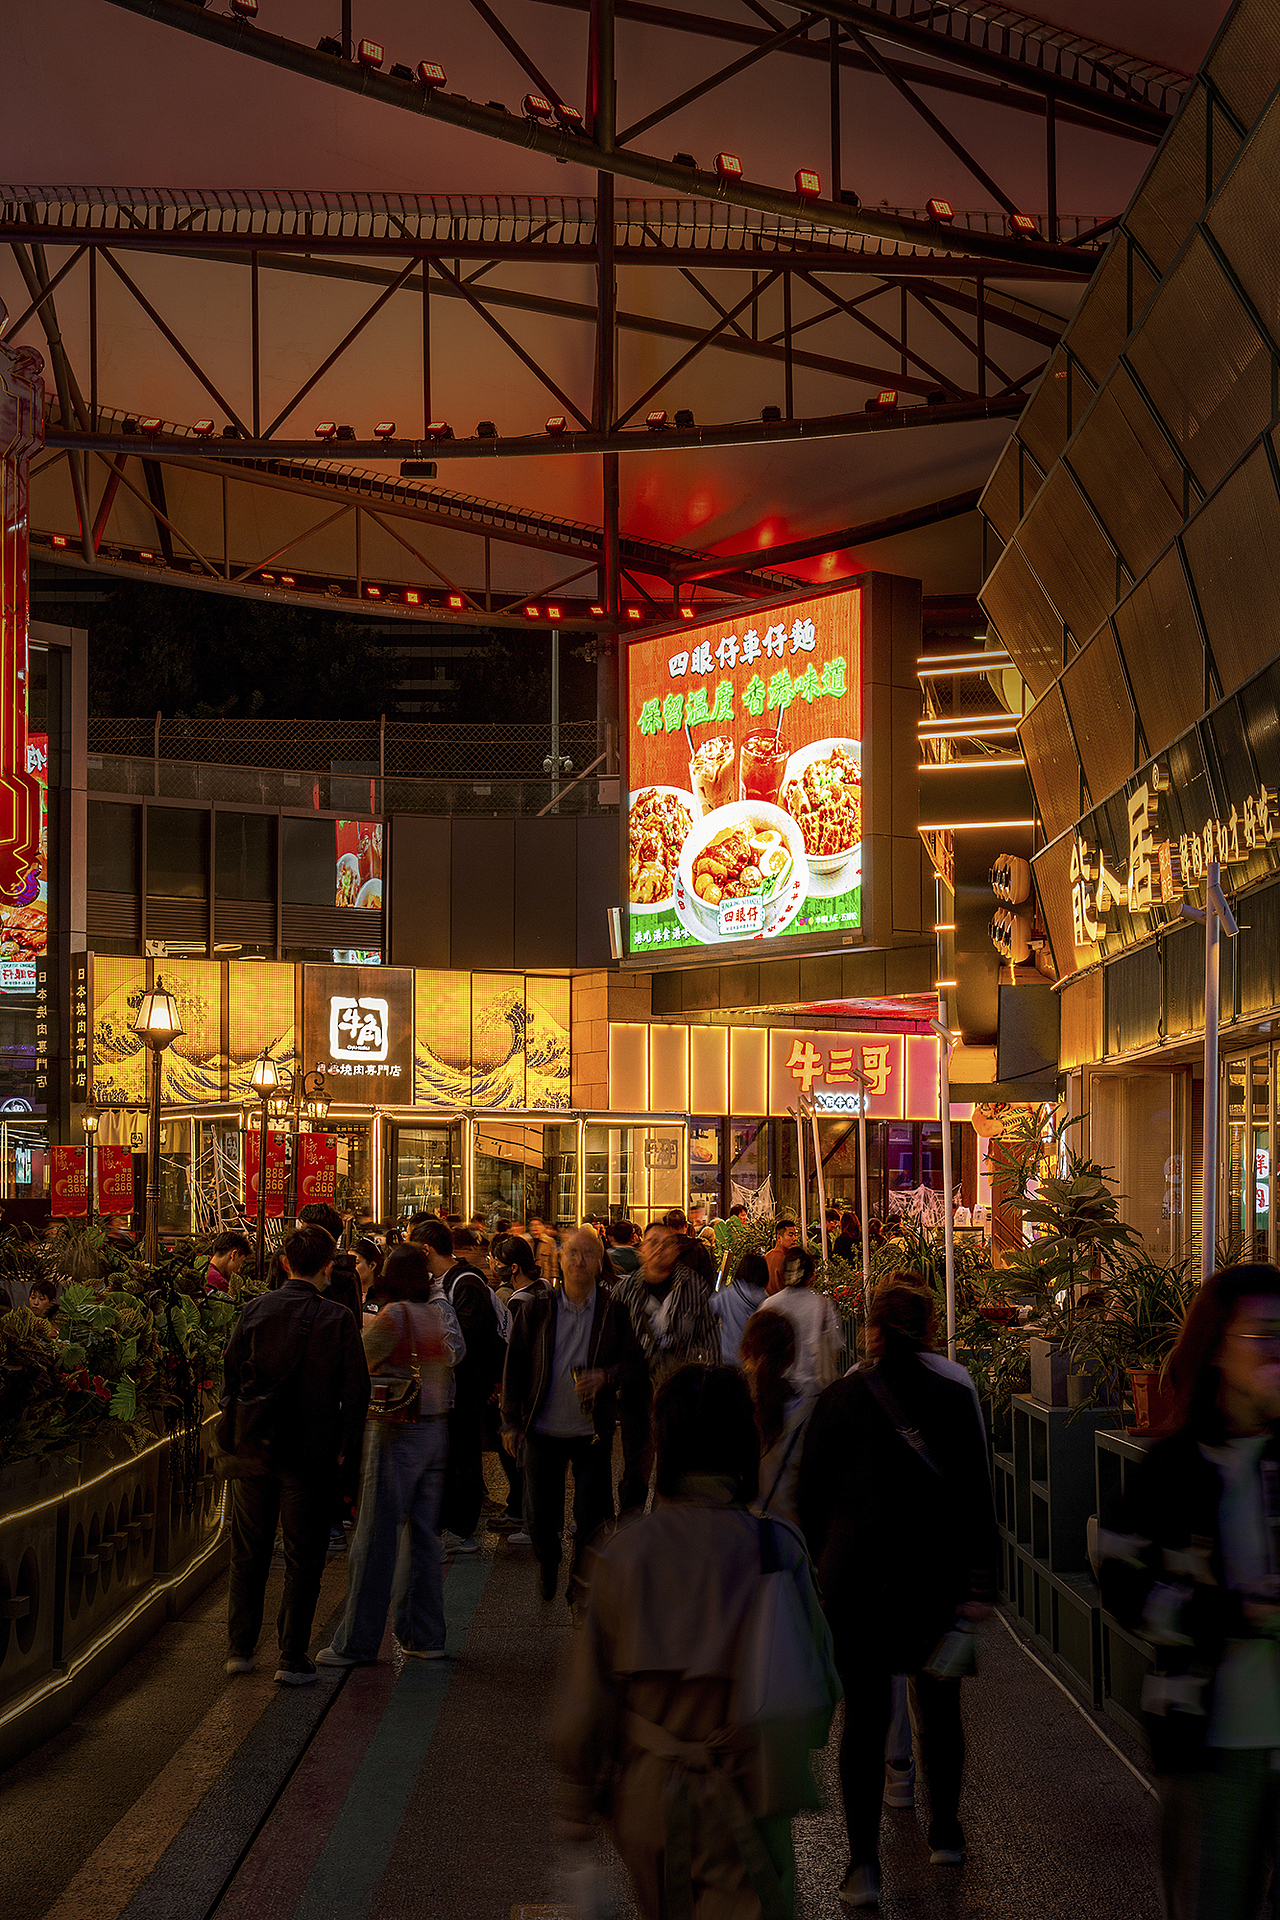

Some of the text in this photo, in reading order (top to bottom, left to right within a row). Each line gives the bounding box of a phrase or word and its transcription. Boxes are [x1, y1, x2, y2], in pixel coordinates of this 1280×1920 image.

[668, 617, 816, 678] 四眼仔車仔麵
[742, 656, 848, 717] 香港味道
[337, 1008, 383, 1047] 牛角
[785, 1038, 892, 1095] 牛三哥
[67, 1175, 85, 1184] 888
[114, 1173, 132, 1182] 888
[316, 1171, 334, 1181] 888
